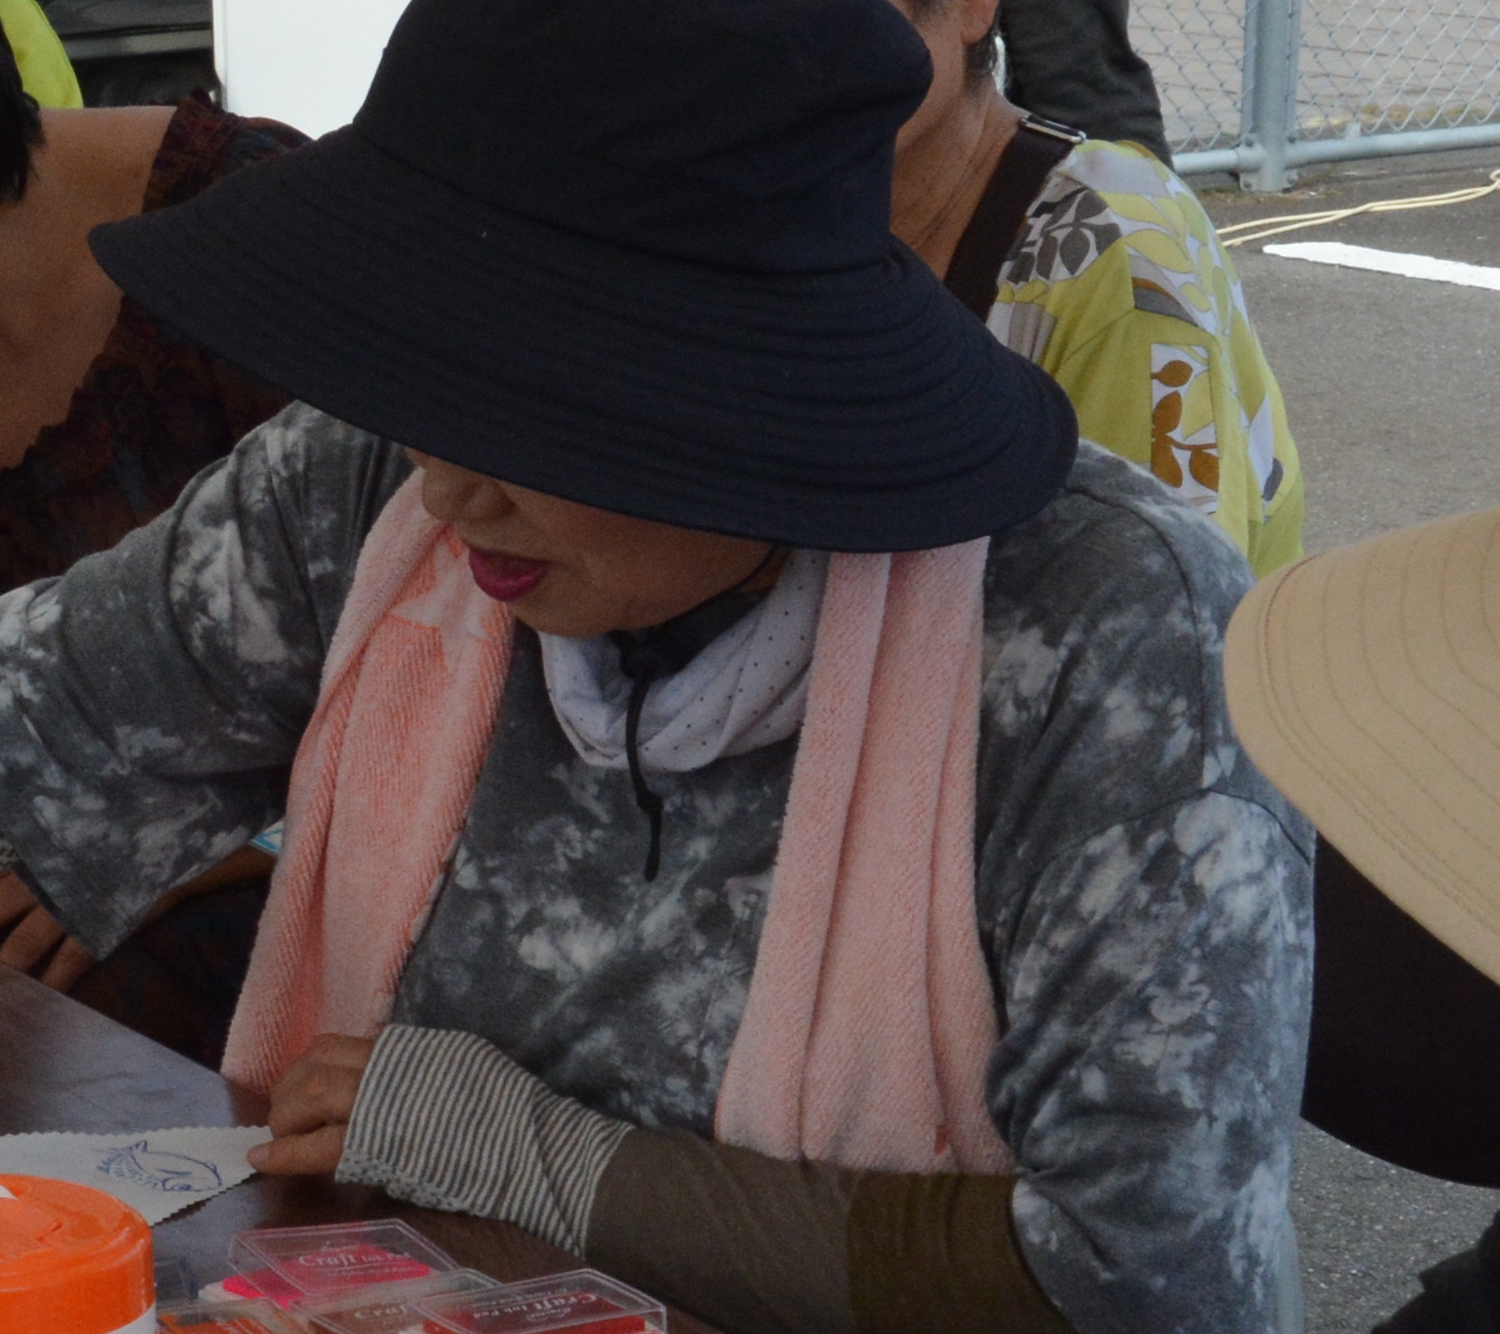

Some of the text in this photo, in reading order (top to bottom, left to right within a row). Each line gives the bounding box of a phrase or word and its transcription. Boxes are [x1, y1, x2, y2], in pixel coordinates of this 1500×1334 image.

[300, 1250, 356, 1270] Craft
[355, 1301, 406, 1322] Craf
[533, 1292, 598, 1312] Craft
